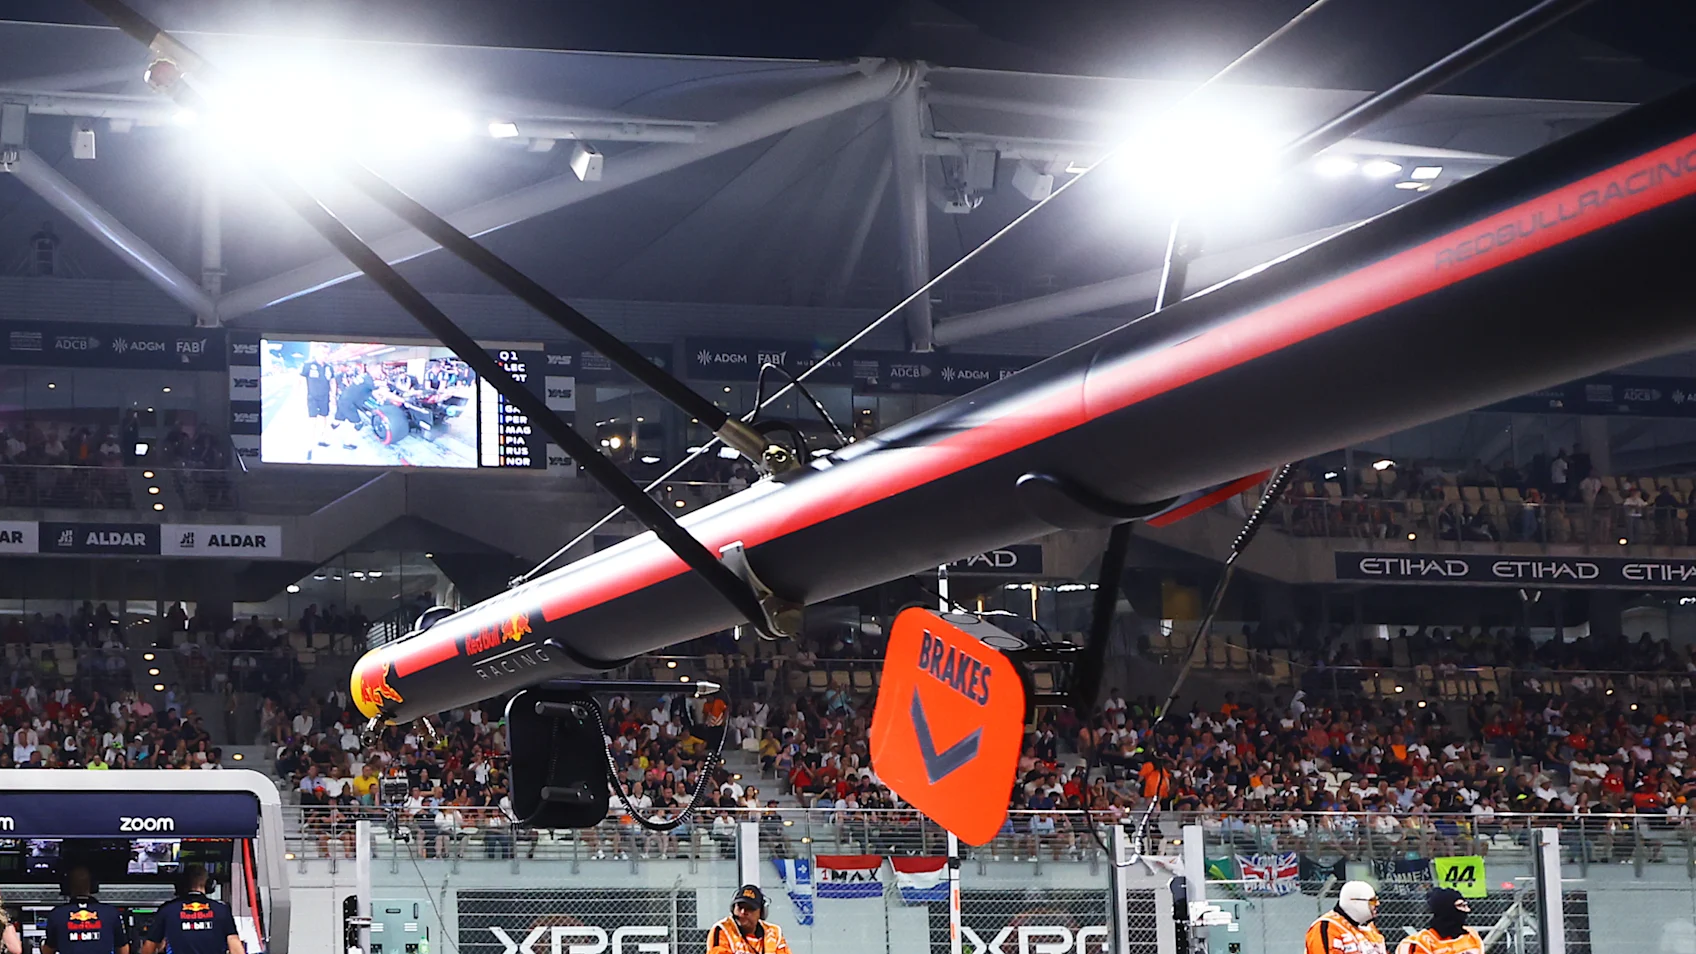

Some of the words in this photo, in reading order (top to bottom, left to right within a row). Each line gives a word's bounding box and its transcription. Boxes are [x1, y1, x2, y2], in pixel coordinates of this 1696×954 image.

[55, 338, 88, 350] ADCB
[129, 341, 166, 352] ADGM
[175, 340, 203, 354] FAB
[232, 344, 259, 355] YAS
[714, 353, 748, 365] ADGM
[757, 353, 781, 366] FAB
[889, 367, 921, 379] ADCB
[957, 369, 990, 381] ADGM
[233, 378, 259, 388] YAS
[505, 415, 529, 425] PER
[505, 426, 533, 436] MAG
[505, 436, 526, 446] PIA
[505, 447, 530, 457] RUS
[505, 457, 532, 467] NOR
[85, 530, 147, 547] ALDAR
[207, 532, 268, 549] ALDAR
[1358, 557, 1470, 578] ETIHAD
[1491, 560, 1600, 580] ETIHAD
[465, 629, 486, 656] Red
[481, 622, 502, 652] Bull
[475, 649, 551, 681] RACING
[917, 628, 993, 708] BRAKES
[119, 816, 176, 832] zoom
[831, 868, 880, 882] MAX
[1444, 865, 1477, 888] 44
[180, 910, 197, 920] Red
[197, 909, 214, 919] Bull
[67, 921, 84, 930] Red
[84, 920, 102, 929] Bull
